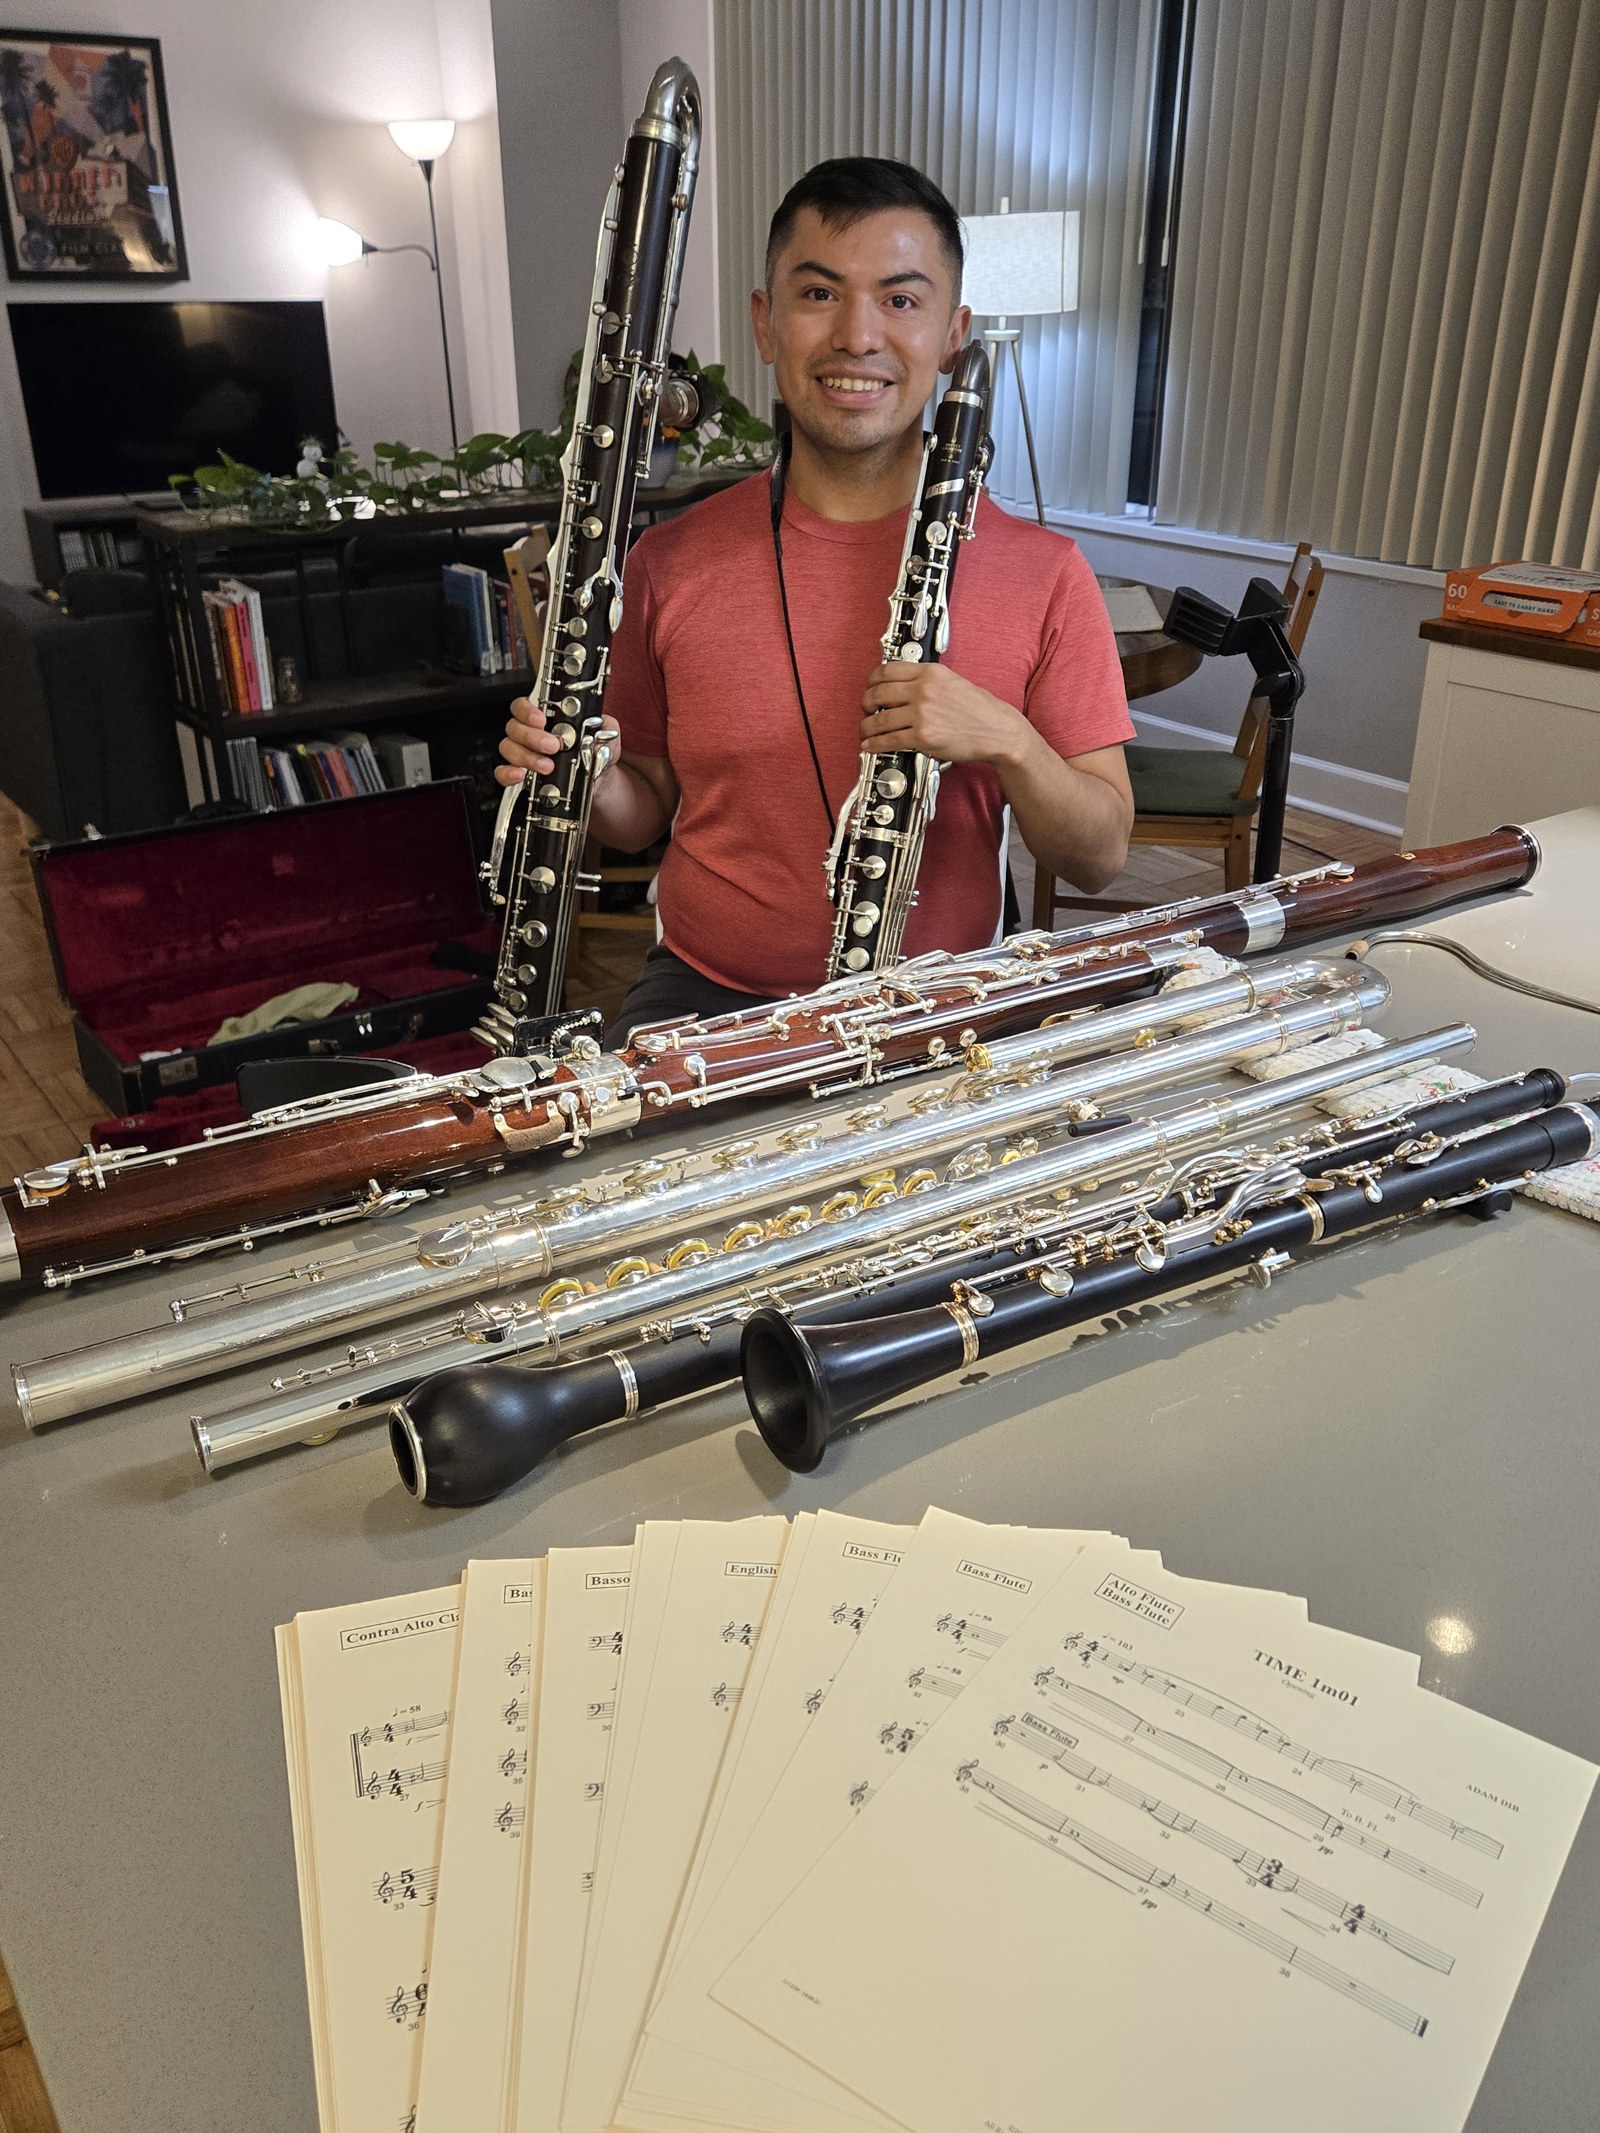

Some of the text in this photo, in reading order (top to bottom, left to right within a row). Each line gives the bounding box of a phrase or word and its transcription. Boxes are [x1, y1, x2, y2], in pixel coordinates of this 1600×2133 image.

[1448, 583, 1467, 599] 60
[849, 1546, 879, 1559] Bass
[730, 1564, 777, 1577] English
[962, 1563, 1026, 1590] Bass Flute
[591, 1576, 630, 1585] Basso
[1102, 1587, 1170, 1625] Bass Flute
[1108, 1580, 1175, 1615] Alto Flute
[346, 1627, 399, 1643] Contra
[404, 1620, 435, 1632] Alto
[1254, 1649, 1358, 1706] TIME 1m01
[1281, 1679, 1317, 1699] Opening
[1025, 1716, 1073, 1745] Bass Flute
[1465, 1784, 1498, 1802] ADAM
[394, 1902, 405, 1910] 33
[408, 2022, 420, 2031] 36
